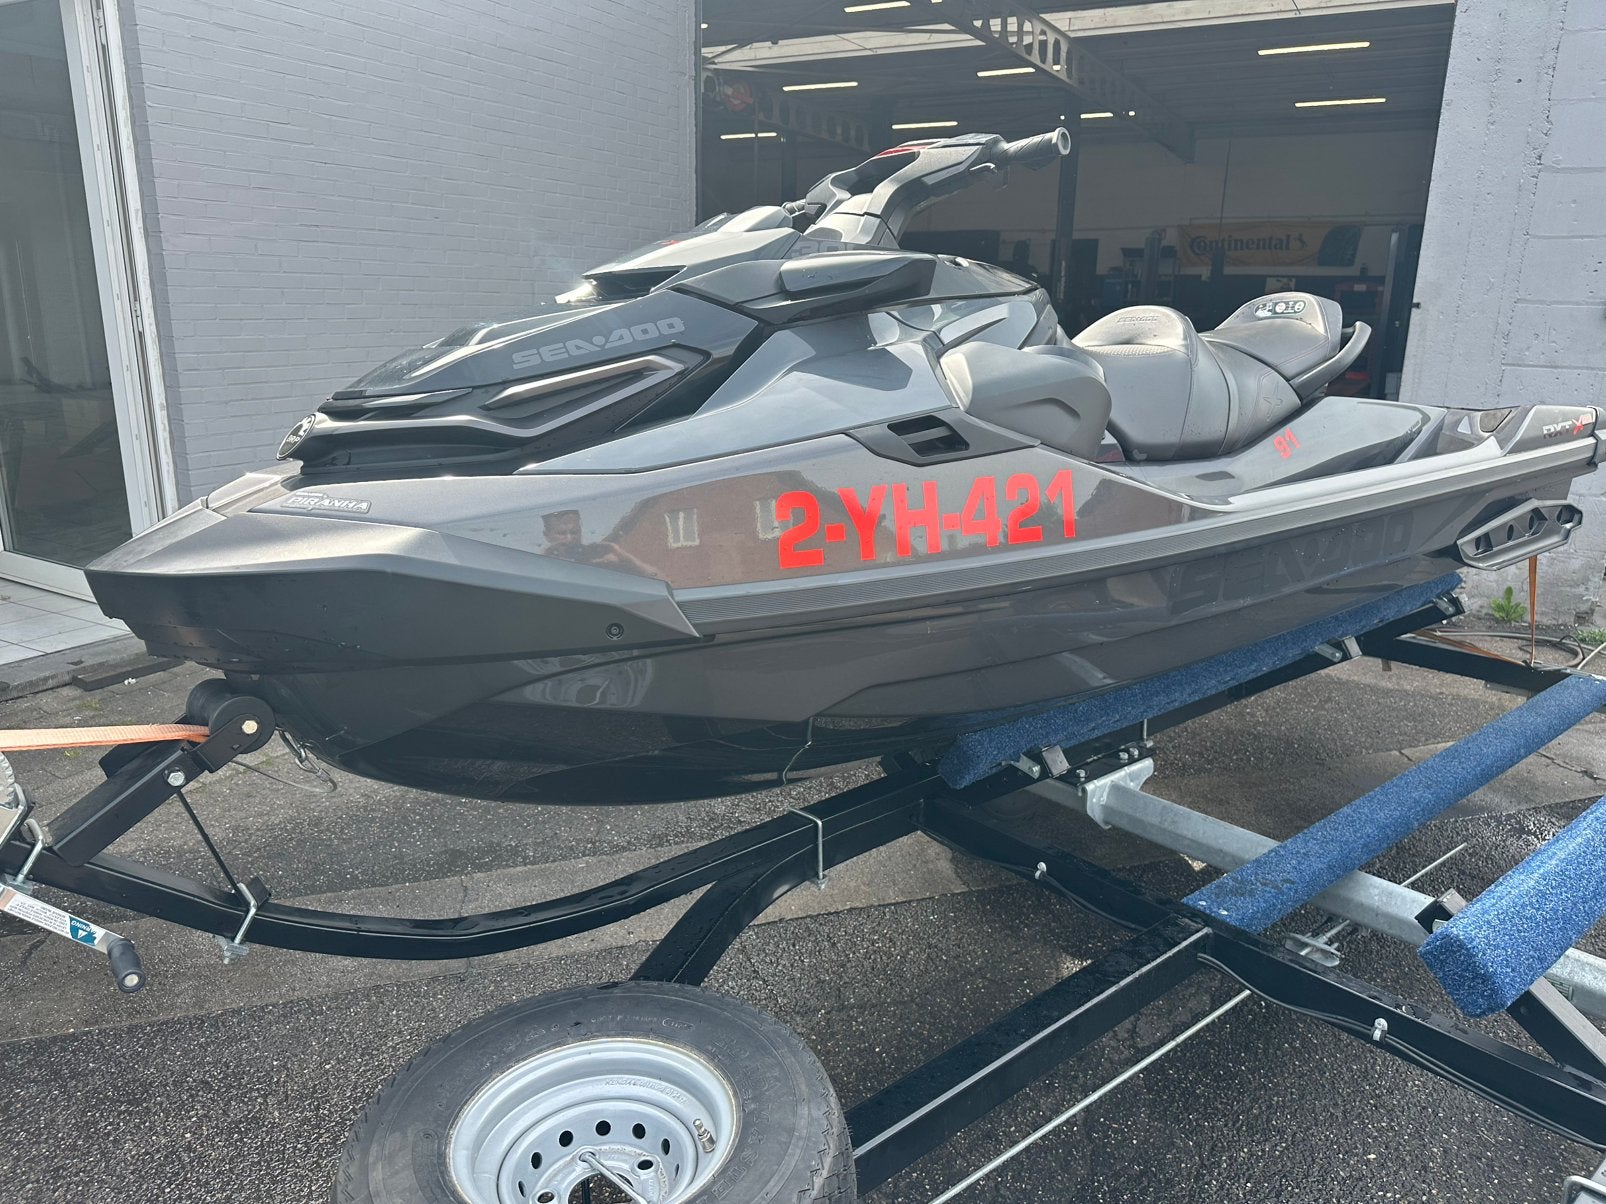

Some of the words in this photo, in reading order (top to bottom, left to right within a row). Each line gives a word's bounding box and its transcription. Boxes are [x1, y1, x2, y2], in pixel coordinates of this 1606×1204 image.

[1189, 233, 1291, 256] Continental
[1273, 428, 1301, 459] 91
[287, 497, 369, 510] PIRANHA
[775, 468, 1077, 569] 2-YH-421
